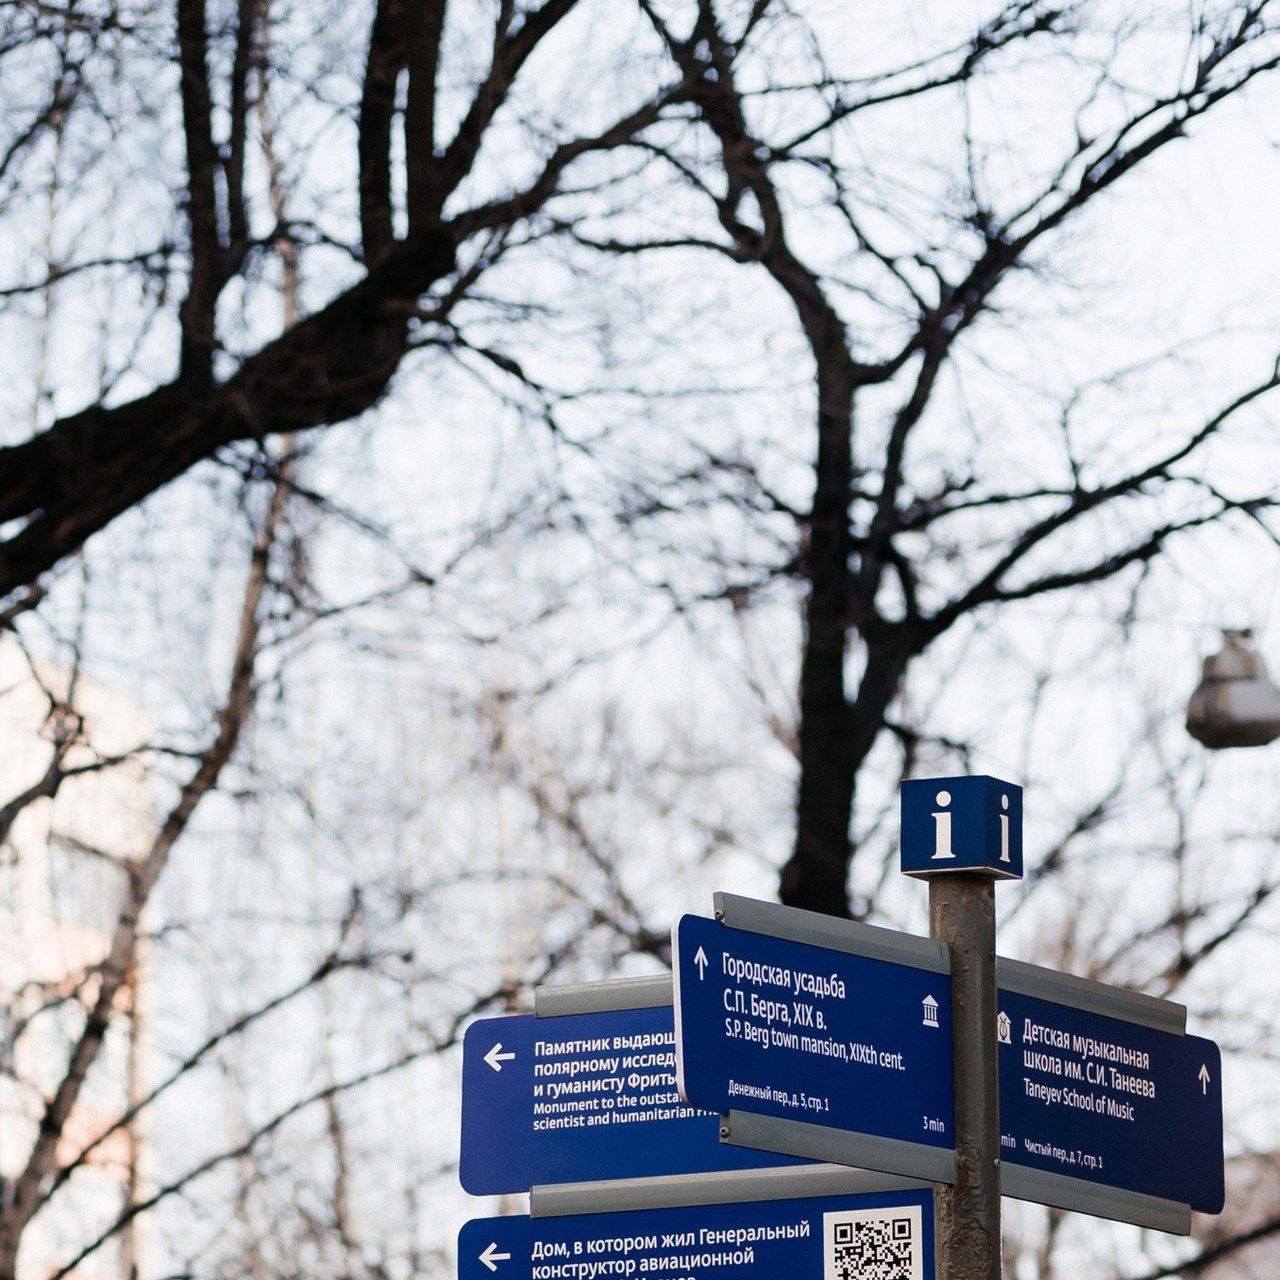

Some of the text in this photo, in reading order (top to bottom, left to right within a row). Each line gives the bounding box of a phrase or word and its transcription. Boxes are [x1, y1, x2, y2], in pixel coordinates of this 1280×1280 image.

[931, 790, 956, 860] i
[999, 794, 1011, 863] i
[722, 952, 846, 999] Городская усадьба
[723, 988, 828, 1030] С.П. Берга, XIX в.
[534, 1038, 610, 1057] Памятник
[725, 1017, 906, 1071] S.P. Berg town mansion, XIXth cent.
[1022, 1018, 1150, 1070] Детская музыкальная
[534, 1052, 678, 1077] полярному исслед
[1023, 1050, 1155, 1099] школа им. С.И. Танеева
[533, 1072, 678, 1100] и гуманисту Фрить
[728, 1079, 772, 1100] Денежный
[824, 1098, 830, 1111] 1
[1023, 1078, 1135, 1122] Taneyev School of Music
[533, 1092, 683, 1115] Monument to the outsta
[533, 1113, 585, 1131] scientist
[587, 1111, 610, 1126] and
[612, 1106, 694, 1124] humanitarian
[922, 1115, 945, 1133] 3 min
[1000, 1133, 1016, 1148] min
[1024, 1138, 1052, 1157] Чистый
[1098, 1156, 1103, 1169] 1
[531, 1220, 811, 1261] Дом, в котором жил Генеральный
[532, 1247, 755, 1280] конструктор авиационной
